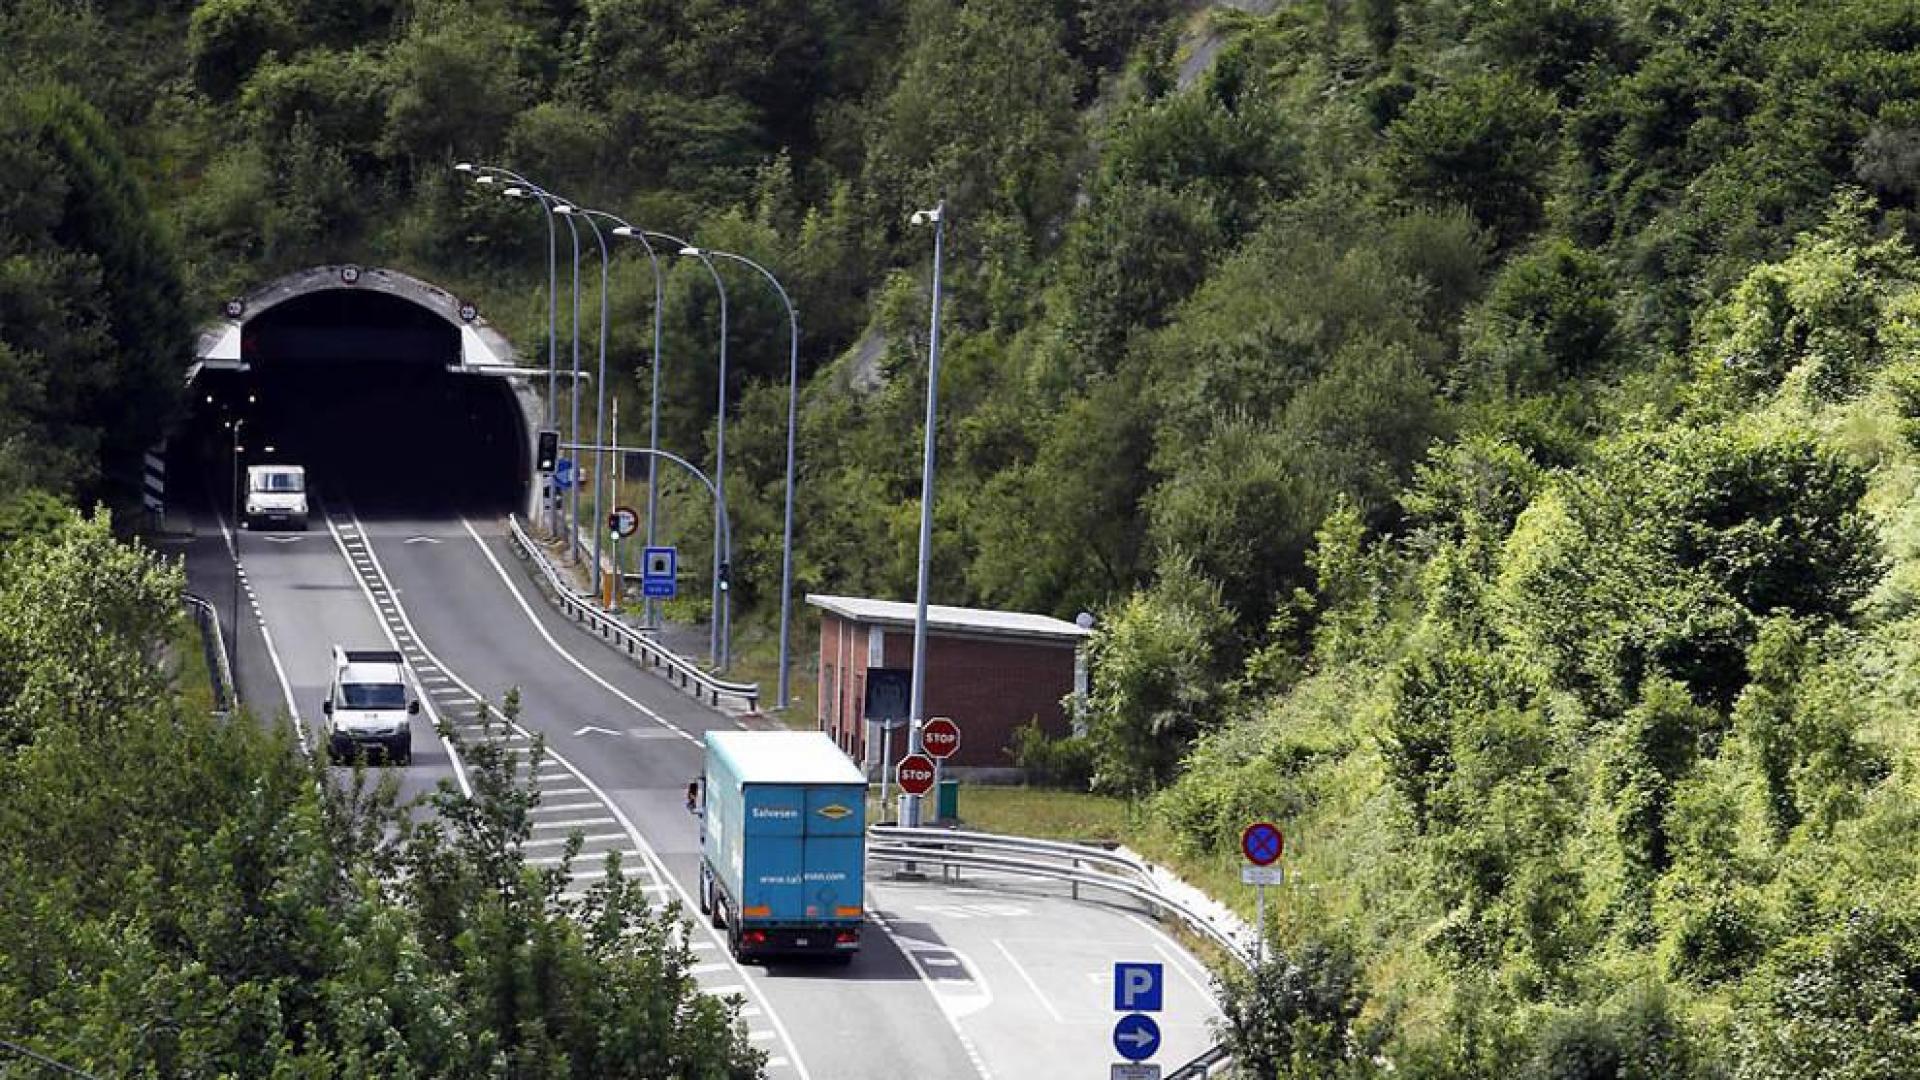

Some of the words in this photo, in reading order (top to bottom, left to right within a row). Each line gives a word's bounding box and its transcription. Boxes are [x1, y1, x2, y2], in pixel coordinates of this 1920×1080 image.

[926, 734, 955, 744] STOP
[901, 769, 931, 780] STOP
[752, 807, 798, 818] Salvesen
[1124, 967, 1153, 1006] P
